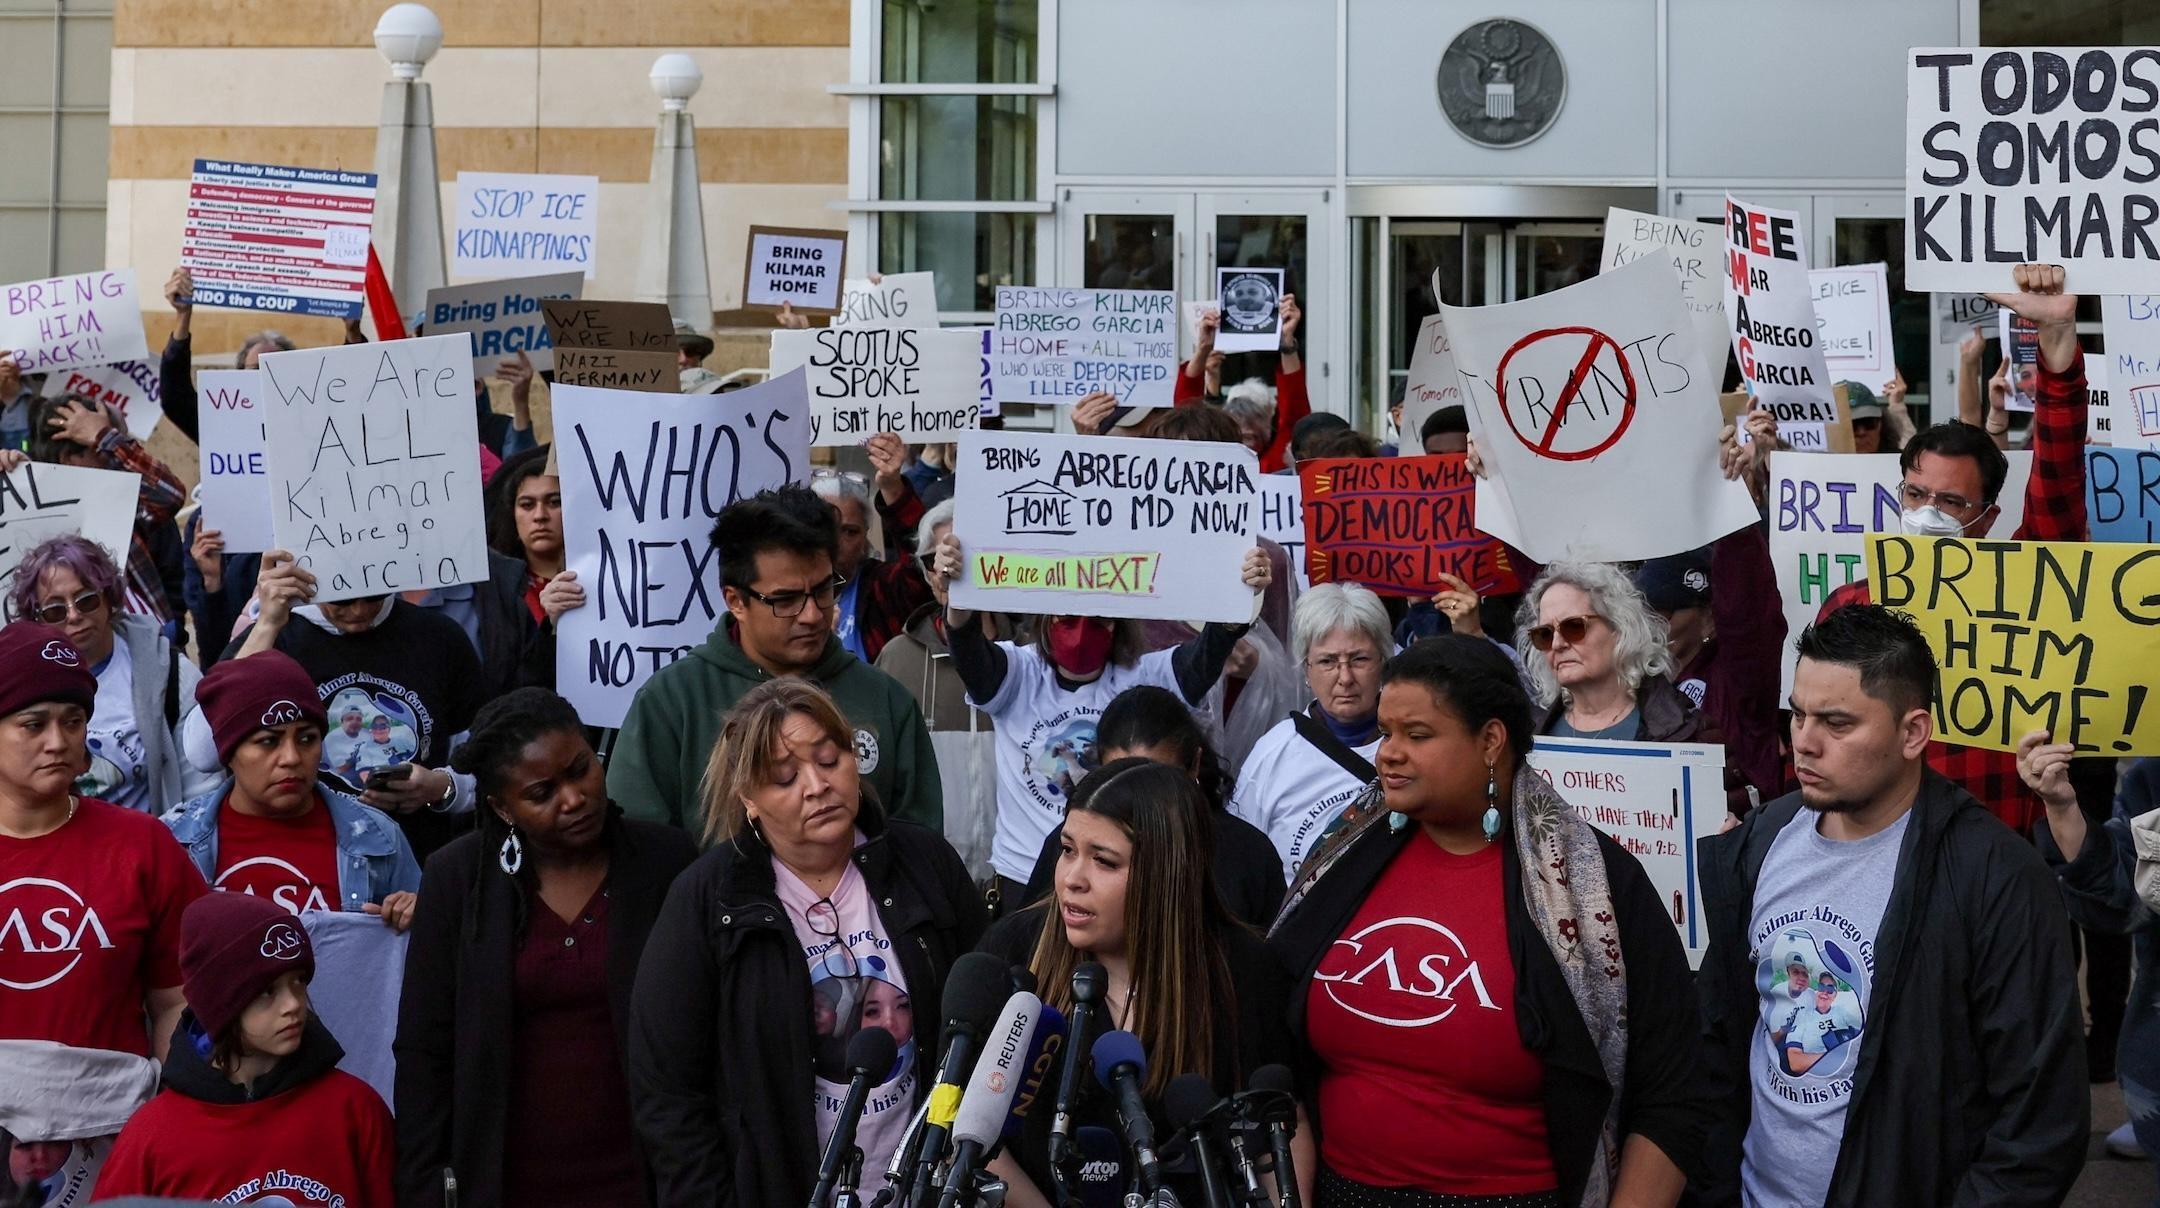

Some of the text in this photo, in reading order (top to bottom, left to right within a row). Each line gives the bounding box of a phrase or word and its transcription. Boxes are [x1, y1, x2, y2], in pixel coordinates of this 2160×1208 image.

[1915, 49, 2160, 116] TODOS
[1922, 118, 2160, 187] SOMOS
[203, 176, 228, 184] Liberty
[206, 161, 367, 184] What Really Makes America Great
[200, 201, 281, 214] Welcoming immigrants
[239, 191, 280, 203] democracy
[285, 195, 316, 205] Consent
[316, 198, 325, 206] of
[325, 198, 338, 206] the
[338, 200, 372, 210] governed
[471, 187, 586, 220] STOP ICE
[197, 221, 227, 229] Keeping
[229, 223, 260, 232] business
[330, 231, 359, 245] FREE
[1633, 217, 1705, 248] BRING
[1726, 198, 1799, 262] FREE
[1914, 192, 2160, 263] KILMAR
[195, 240, 285, 254] Environmental protection
[456, 228, 592, 263] KIDNAPPINGS
[771, 245, 823, 260] BRING
[192, 259, 223, 267] Freedom
[277, 267, 311, 277] assembly
[765, 262, 826, 278] KILMAR
[8, 272, 126, 316] BRING
[192, 289, 298, 311] NDO the COUP
[246, 284, 289, 293] Constitution
[769, 279, 818, 294] HOME
[998, 290, 1174, 315] BRING KILMAR
[433, 300, 497, 324] Bring
[547, 308, 608, 329] WE
[836, 288, 908, 326] BRING
[1736, 296, 1813, 349] ABREGO
[39, 308, 103, 343] HIM
[558, 329, 672, 347] ARE NOT
[999, 312, 1164, 335] ABREGO GARCIA
[13, 336, 105, 372] BACK!!
[560, 352, 618, 370] NAZI
[810, 329, 919, 367] SCOTUS
[1001, 336, 1069, 357] HOME
[1134, 341, 1174, 359] THOSE
[1739, 336, 1815, 387] GARCIA
[65, 373, 103, 397] FOR
[265, 350, 457, 406] We Are
[560, 368, 662, 387] GERMANY
[816, 366, 919, 398] SPOKE
[1000, 360, 1167, 381] WHO WERE DEPORTED
[1459, 333, 1691, 429] TYRANTS
[206, 388, 254, 410] We
[1411, 383, 1458, 402] Tomorro
[833, 405, 869, 433] isn't
[877, 403, 905, 432] he
[911, 401, 979, 431] home?
[312, 408, 446, 472] ALL
[210, 452, 266, 475] DUE
[574, 409, 790, 524] WHO'S
[982, 447, 1256, 496] BRING ABREGO GARCIA
[1328, 461, 1475, 493] THIS IS WHA
[286, 471, 455, 522] Kilmar
[1778, 478, 1901, 533] BRIN
[1006, 494, 1249, 537] HOME TO MD NOW!
[1308, 495, 1477, 543] DEMOCRA
[305, 518, 434, 550] Abrego
[597, 528, 719, 628] NEX
[980, 553, 1162, 594] We are all NEXT!
[1331, 550, 1415, 585] LOOKS
[1423, 544, 1495, 586] LIKE
[1875, 537, 2160, 626] BRING
[1944, 619, 2094, 686] HIM
[317, 672, 356, 700] ilmar
[1026, 778, 1053, 811] Home
[1563, 770, 1626, 793] OTHERS
[1290, 788, 1354, 857] Bring Kilmar
[1595, 804, 1631, 826] HAVE
[1633, 809, 1674, 831] THEM
[1808, 904, 1862, 943] Abrego
[1312, 939, 1503, 1011] CASA
[997, 1012, 1029, 1070] REUTERS
[872, 1093, 899, 1114] his
[1801, 1086, 1829, 1104] his
[262, 1169, 331, 1202] Abrego
[1081, 1171, 1109, 1182] news
